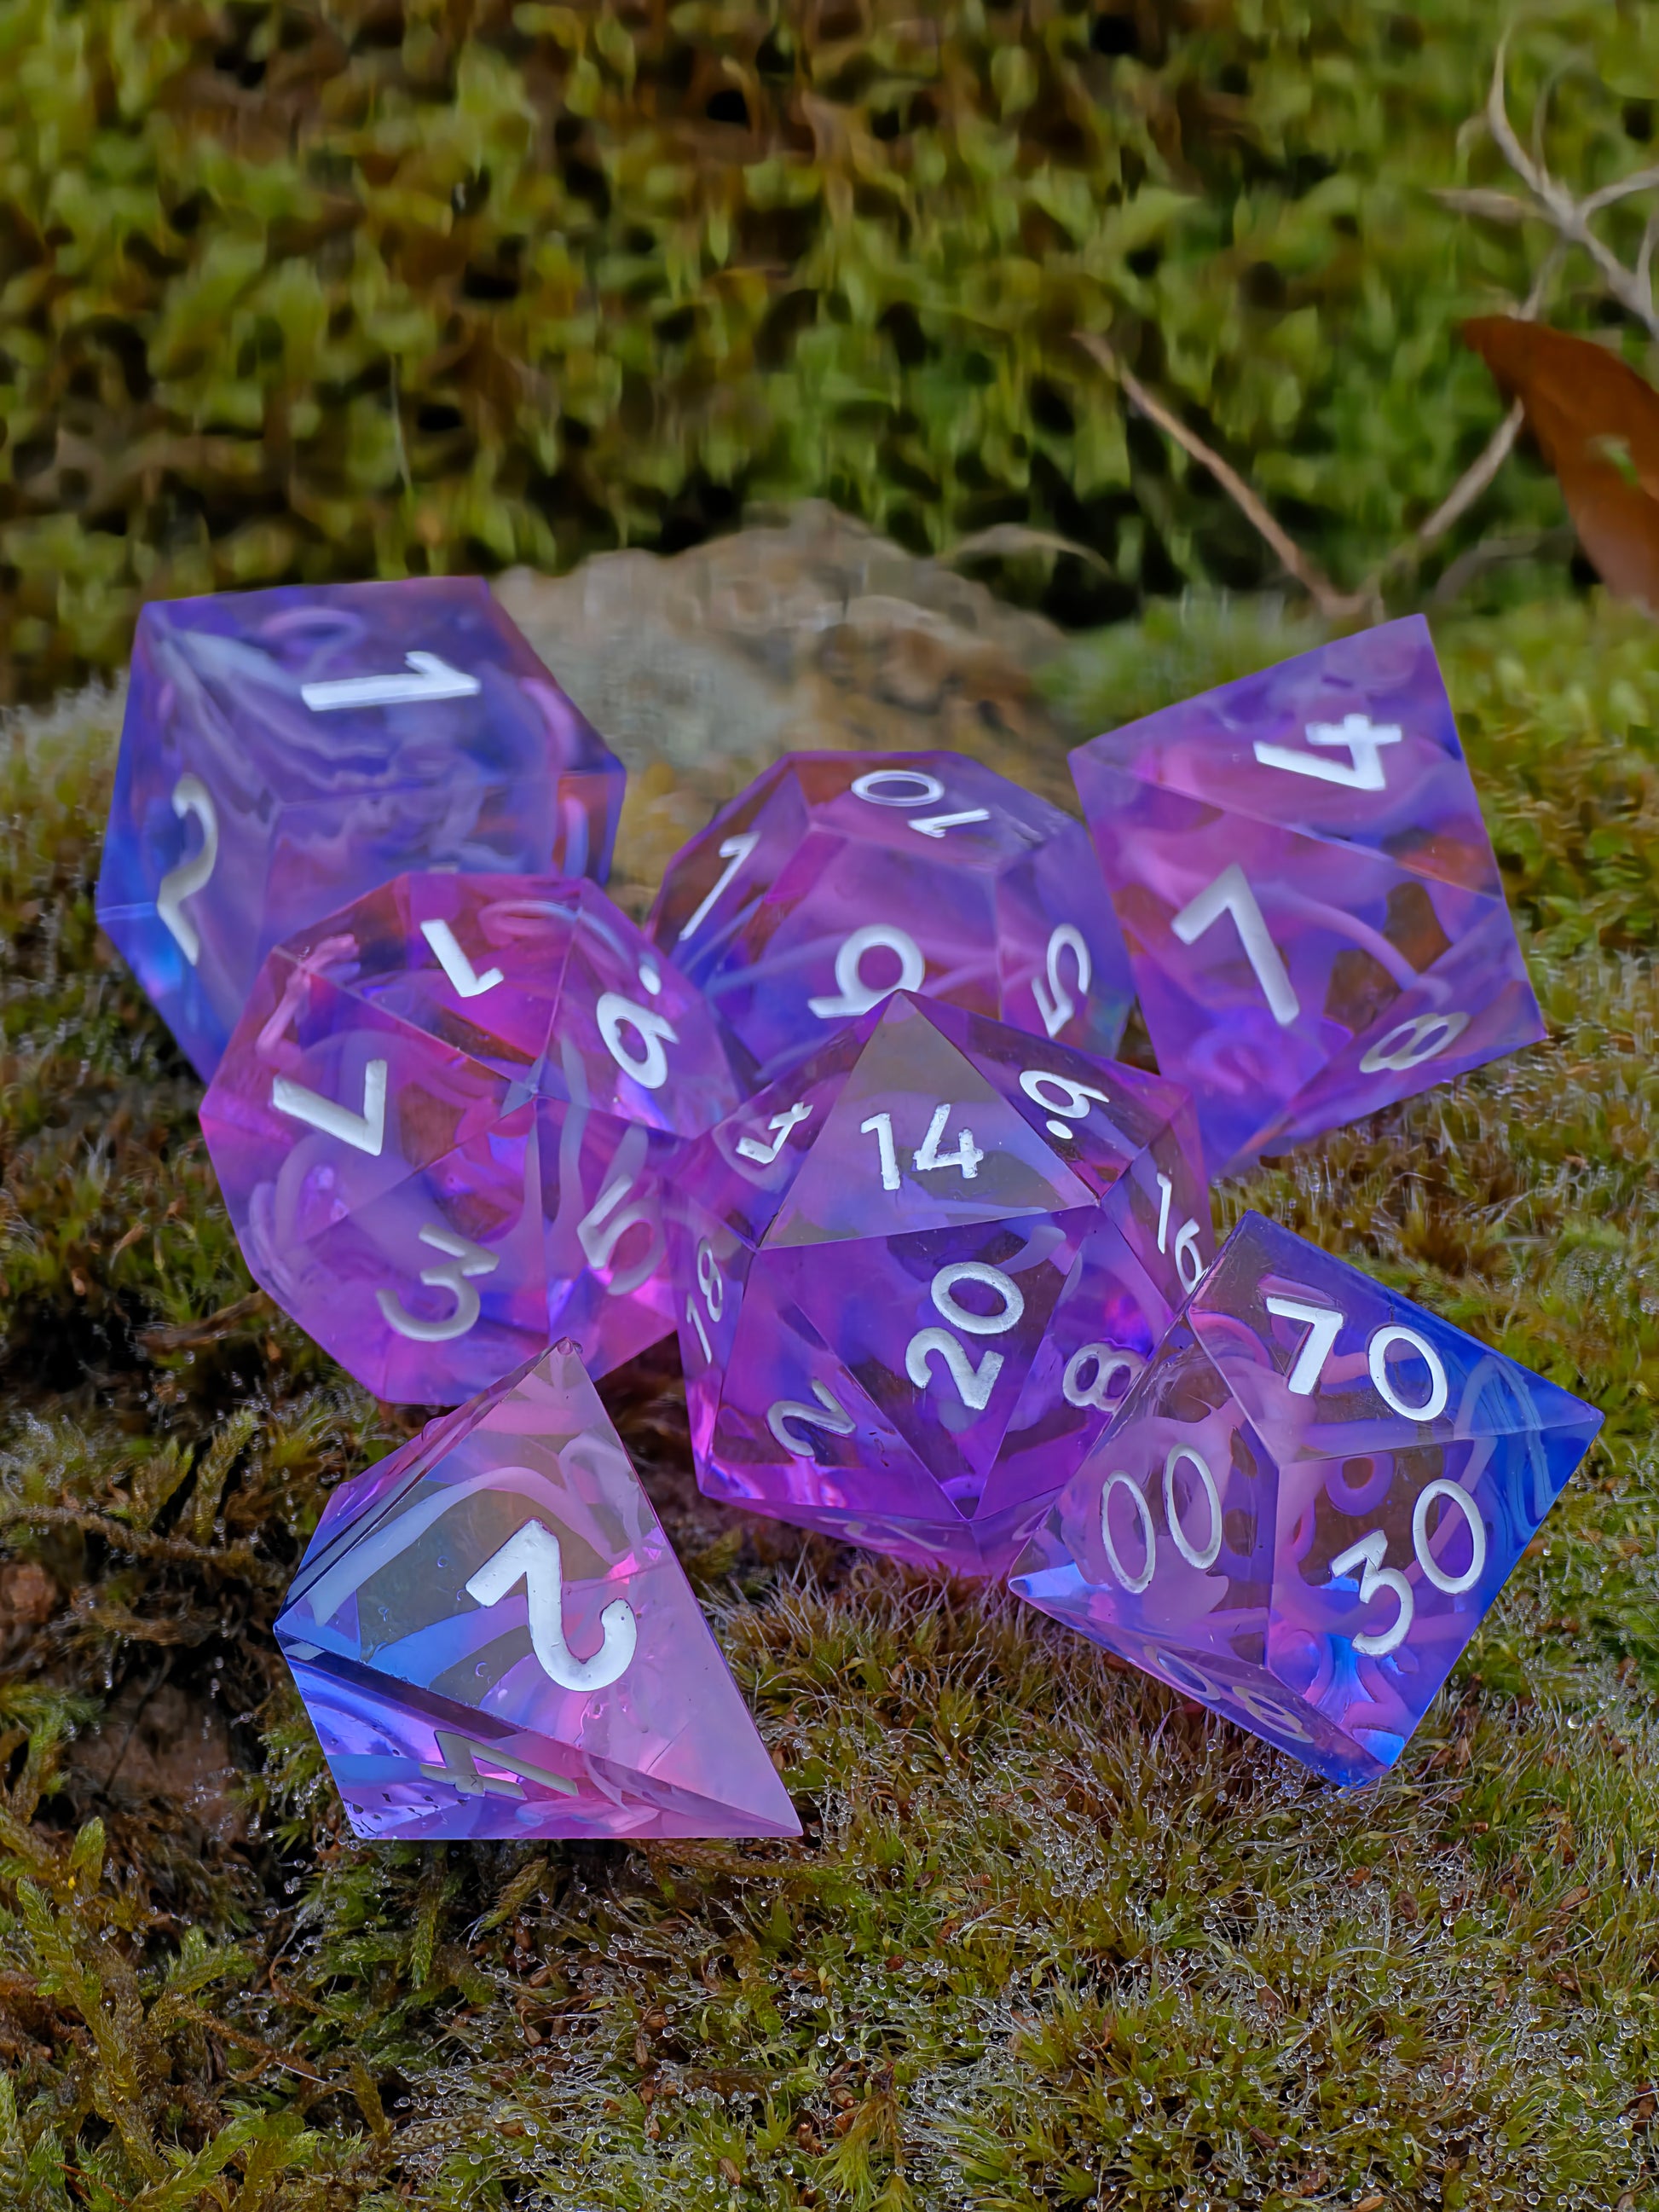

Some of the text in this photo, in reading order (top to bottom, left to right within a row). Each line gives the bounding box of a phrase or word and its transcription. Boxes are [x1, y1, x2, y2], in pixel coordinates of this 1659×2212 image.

[301, 651, 481, 711] 1
[852, 769, 991, 838] 10
[1252, 714, 1402, 791] 4
[157, 771, 218, 966] 2
[1032, 923, 1092, 1039] 5
[1171, 863, 1300, 1024] 7
[1360, 1012, 1469, 1074] 8
[273, 1059, 388, 1156] 7
[736, 1102, 814, 1164] 4
[860, 1103, 984, 1190] 14
[376, 1223, 500, 1342] 3
[1157, 1173, 1204, 1295] 16
[905, 1260, 1025, 1410] 20
[1062, 1341, 1145, 1413] 8
[1266, 1295, 1448, 1422] 70
[766, 1377, 856, 1457] 2
[1101, 1446, 1223, 1595] 00
[1331, 1479, 1486, 1656] 30
[465, 1515, 638, 1692] 2
